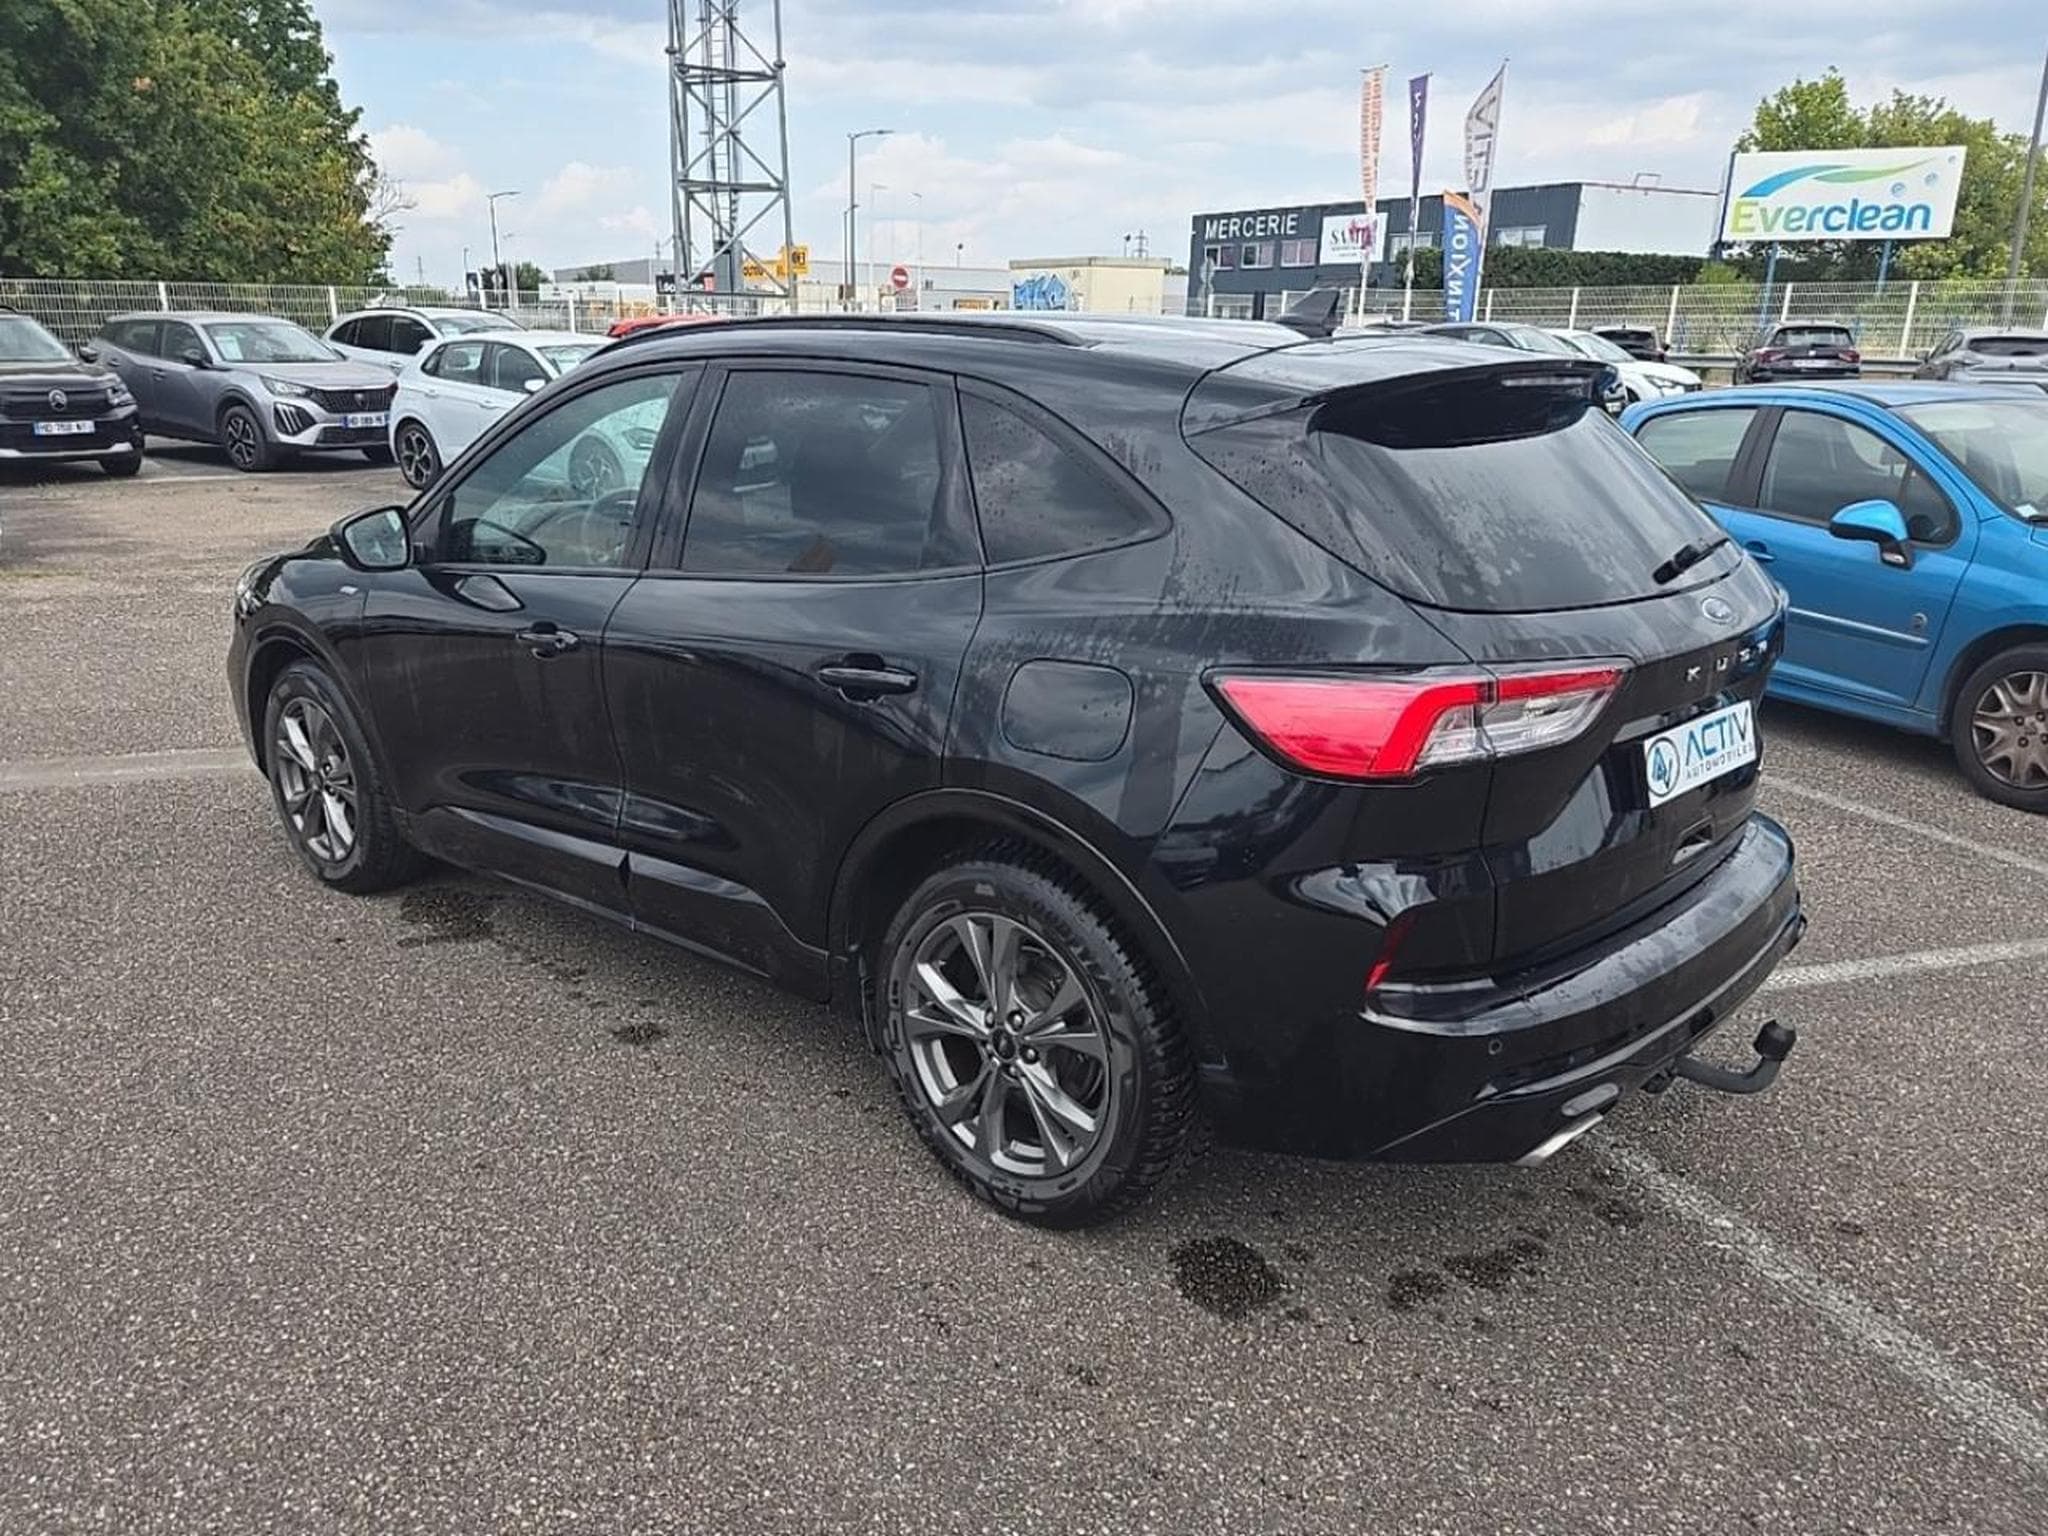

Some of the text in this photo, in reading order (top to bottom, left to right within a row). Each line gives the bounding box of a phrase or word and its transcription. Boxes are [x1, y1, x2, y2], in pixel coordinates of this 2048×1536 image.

[1204, 213, 1299, 240] MERCERIE
[1730, 198, 1932, 233] Everclean
[1685, 706, 1749, 767] ACTIV
